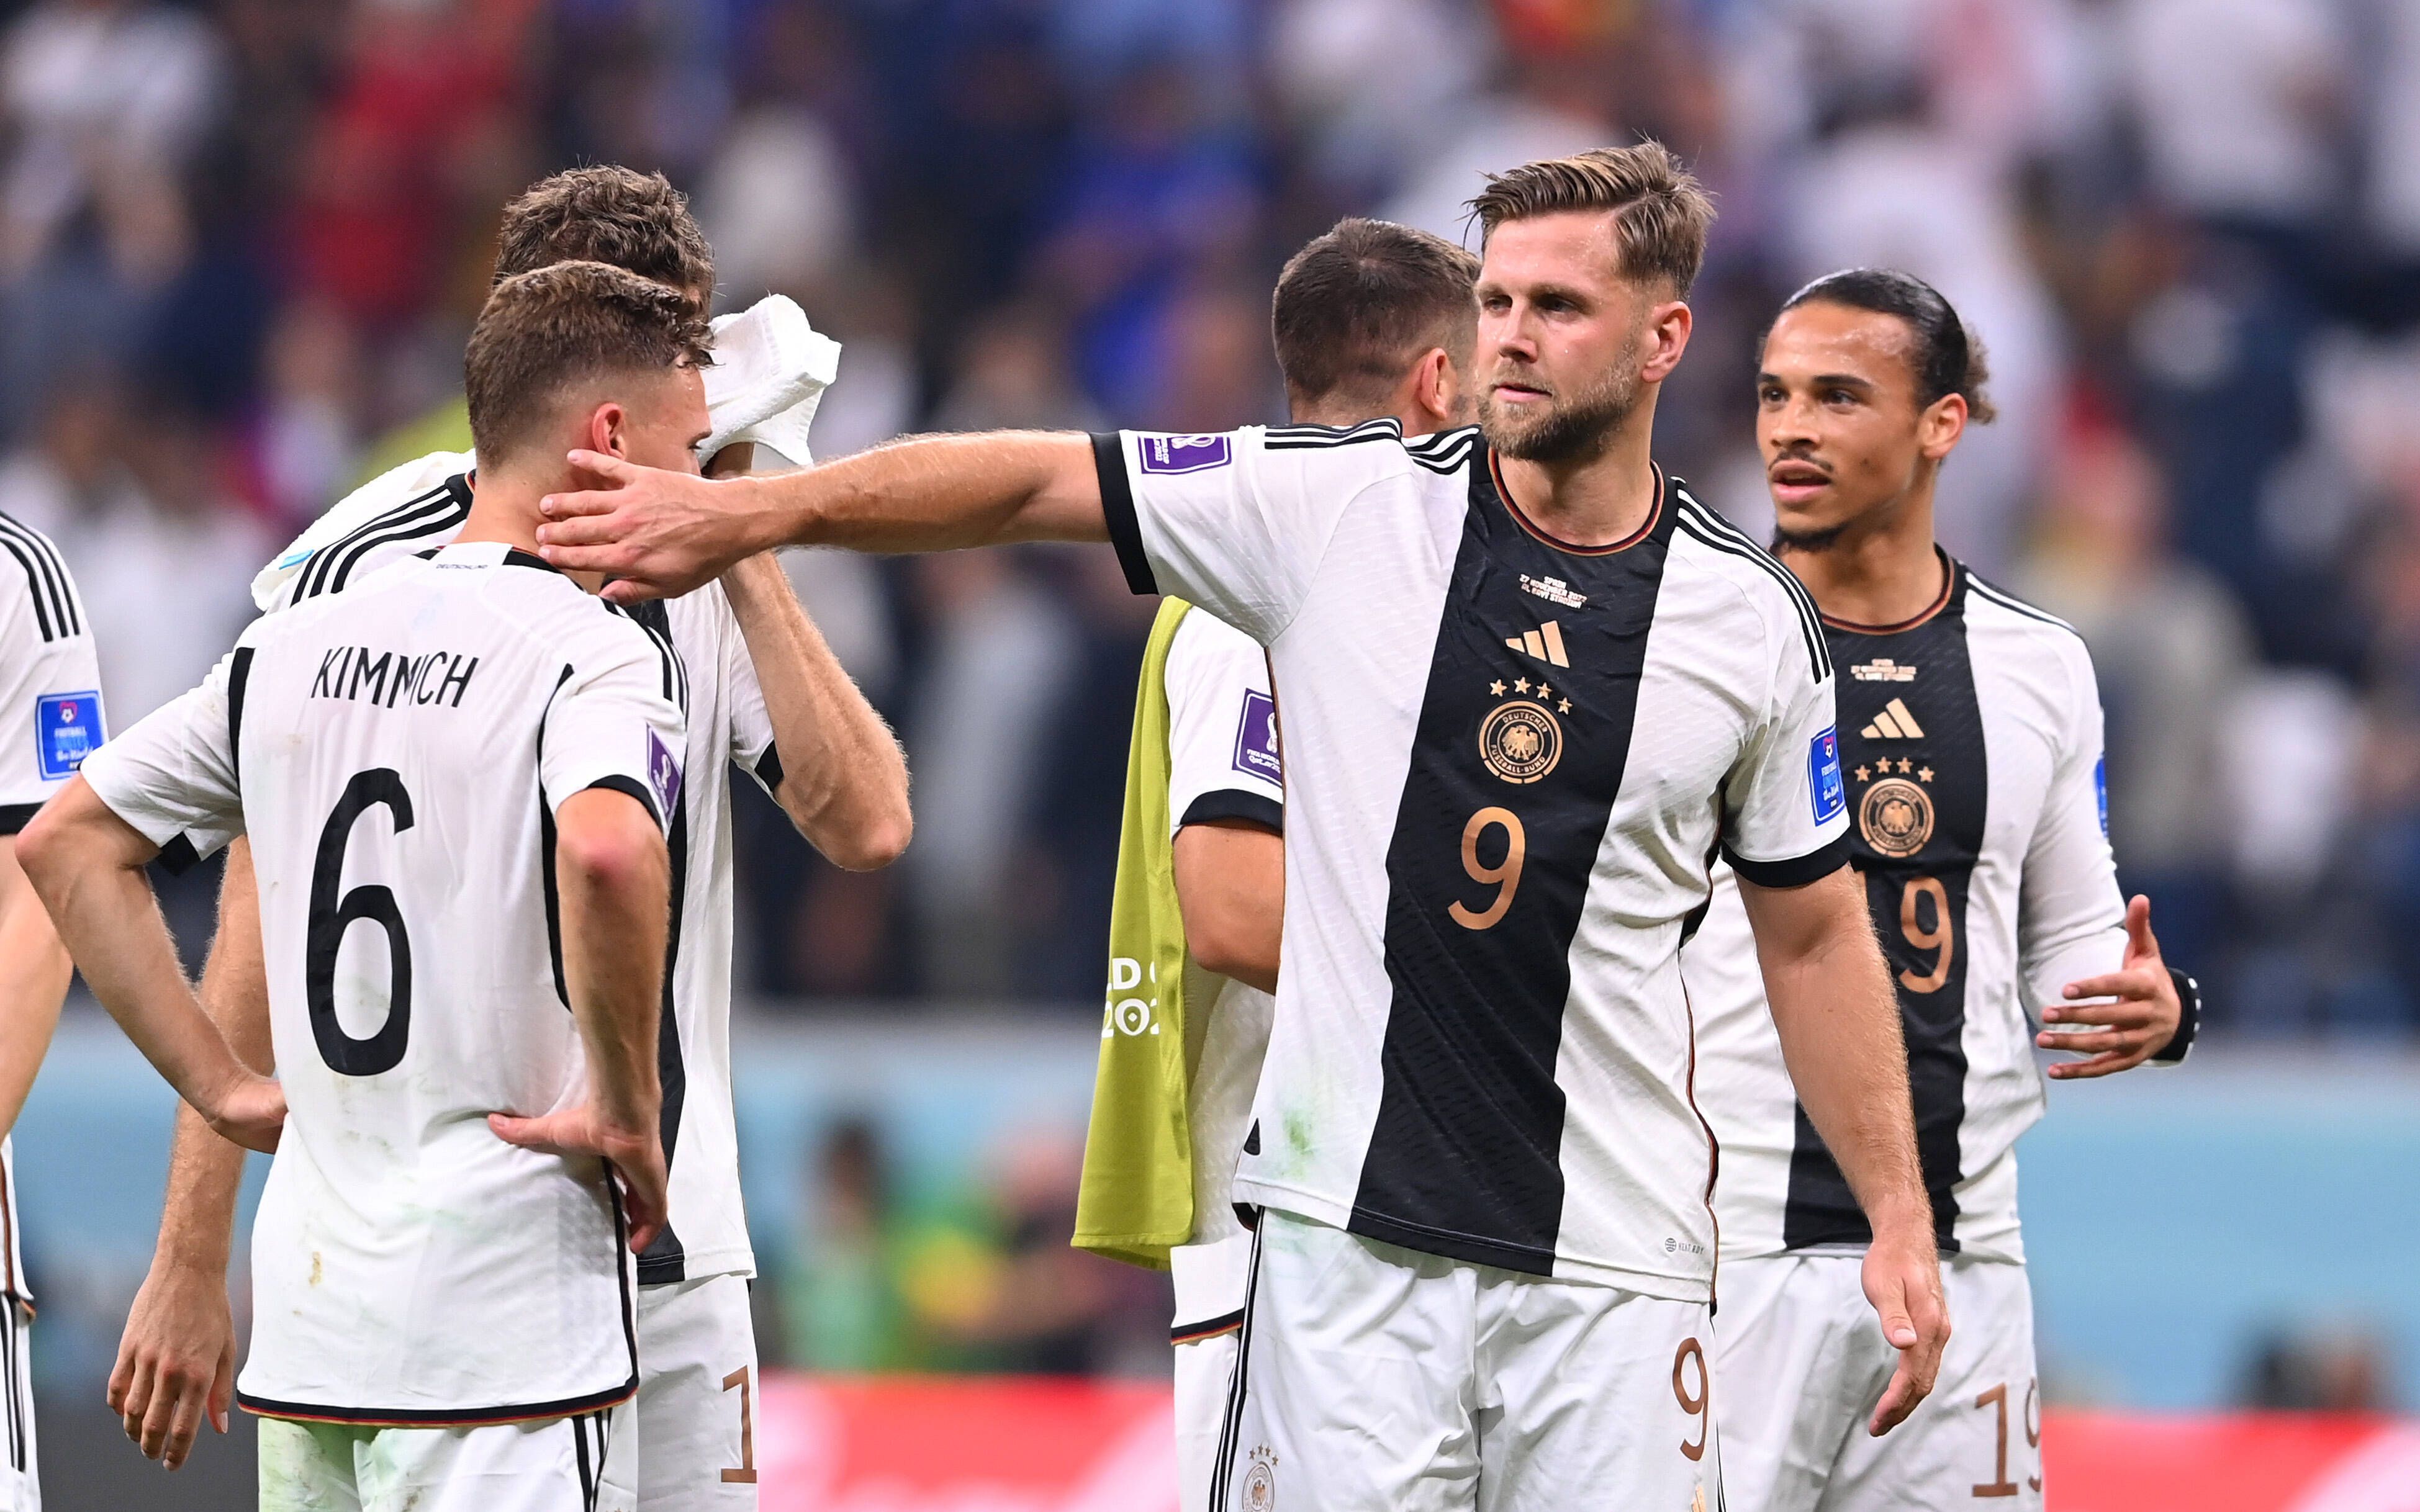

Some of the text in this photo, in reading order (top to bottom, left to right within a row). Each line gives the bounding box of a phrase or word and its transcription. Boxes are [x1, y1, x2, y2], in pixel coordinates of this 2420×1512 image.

[310, 646, 480, 709] KIMMICH
[1502, 712, 1548, 733] DEUTSCHER
[306, 767, 415, 1076] 6
[1447, 806, 1526, 930] 9
[1854, 871, 1954, 994] 9
[721, 1364, 757, 1484] 1
[1672, 1337, 1709, 1462] 9
